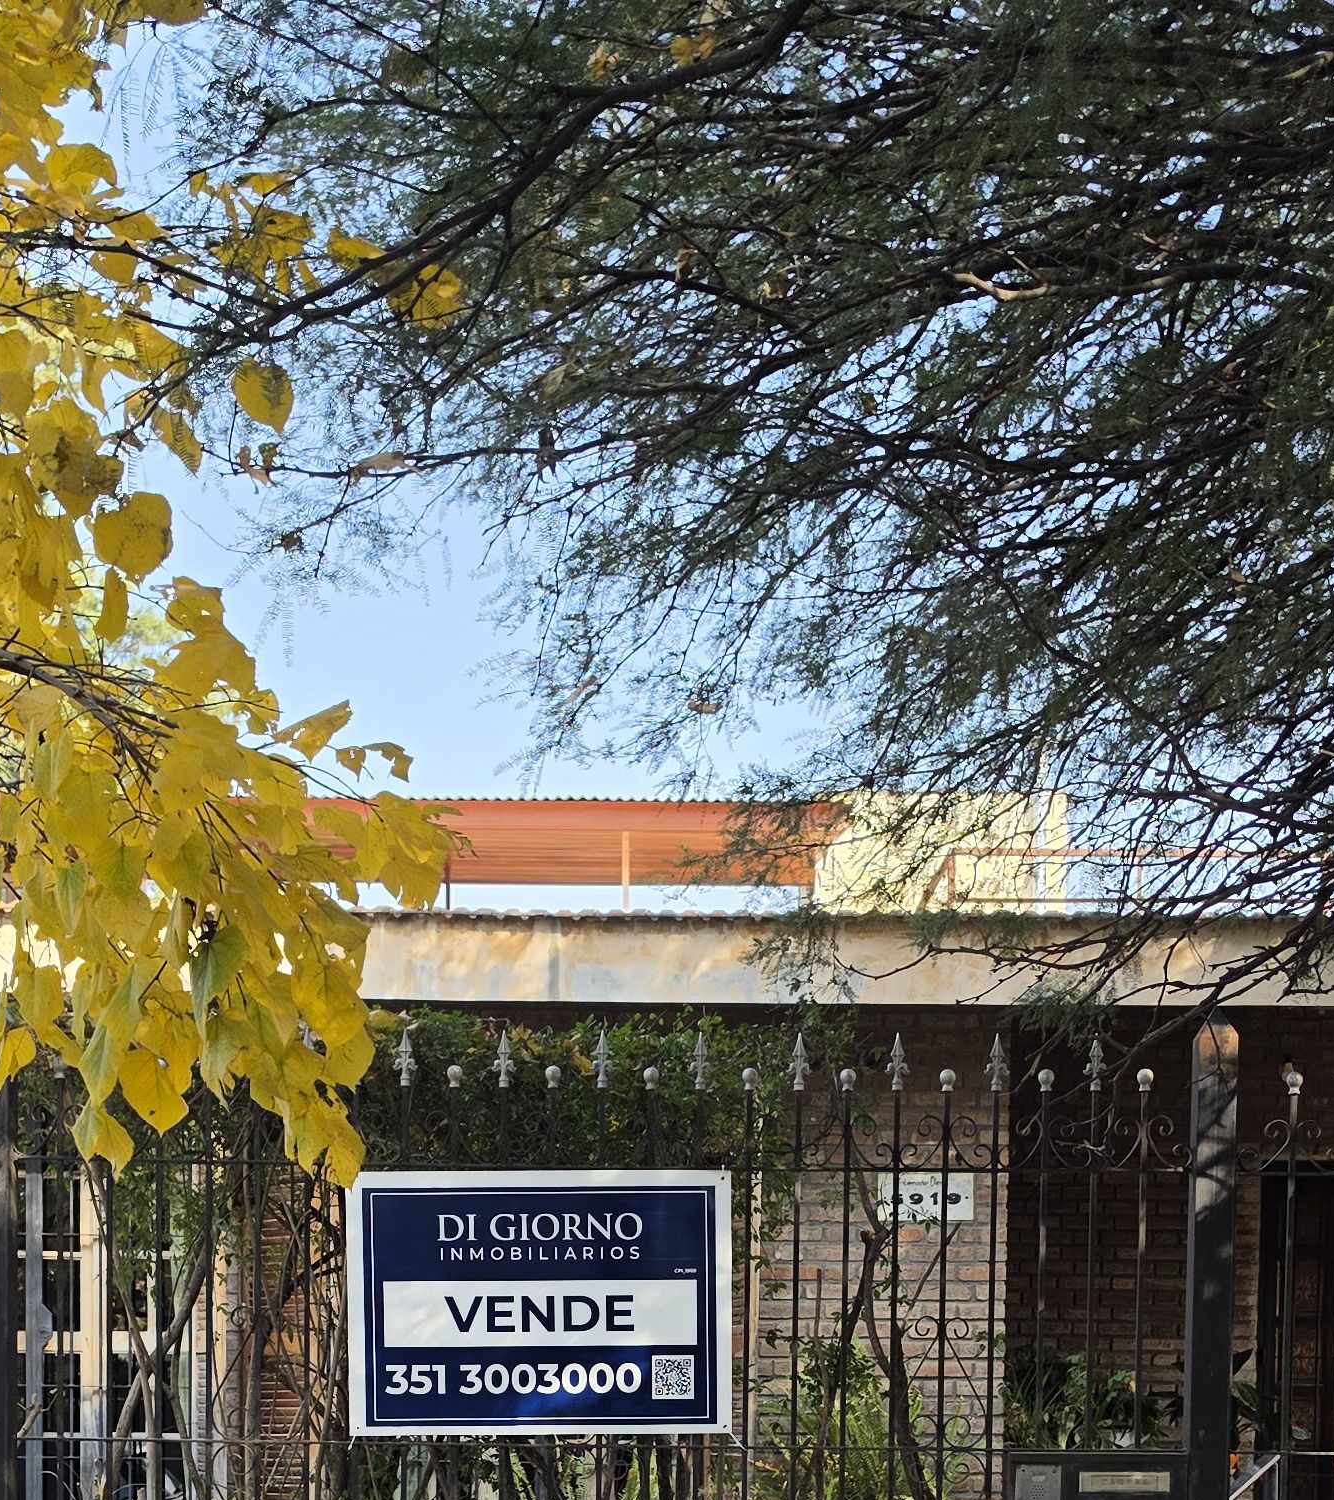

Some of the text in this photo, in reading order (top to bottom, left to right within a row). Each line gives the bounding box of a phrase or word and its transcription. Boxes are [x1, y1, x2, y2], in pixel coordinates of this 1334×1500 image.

[437, 1212, 643, 1241] DI GIORNO
[440, 1246, 641, 1261] INMOBILIARIOS
[444, 1294, 635, 1333] VENDE
[385, 1362, 643, 1395] 351 3003000
